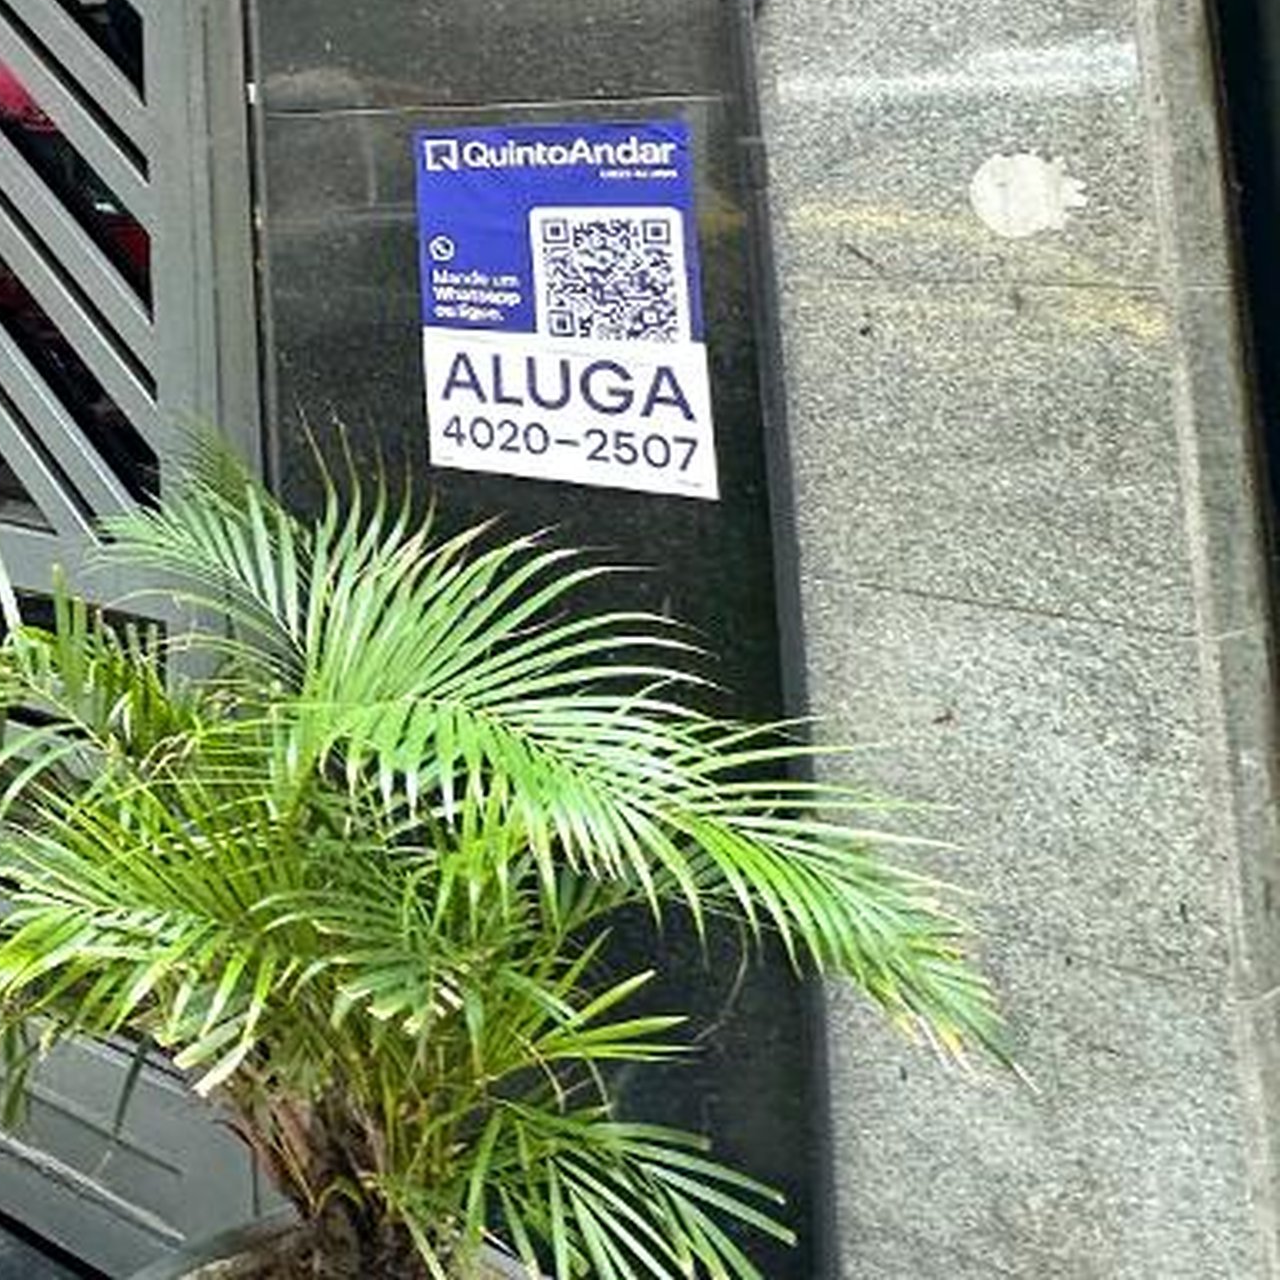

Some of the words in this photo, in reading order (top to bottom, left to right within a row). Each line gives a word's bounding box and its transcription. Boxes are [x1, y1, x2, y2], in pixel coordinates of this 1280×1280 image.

[463, 136, 676, 168] QuintoAndar
[441, 351, 696, 422] ALUGA
[442, 414, 699, 472] 4020-2507
